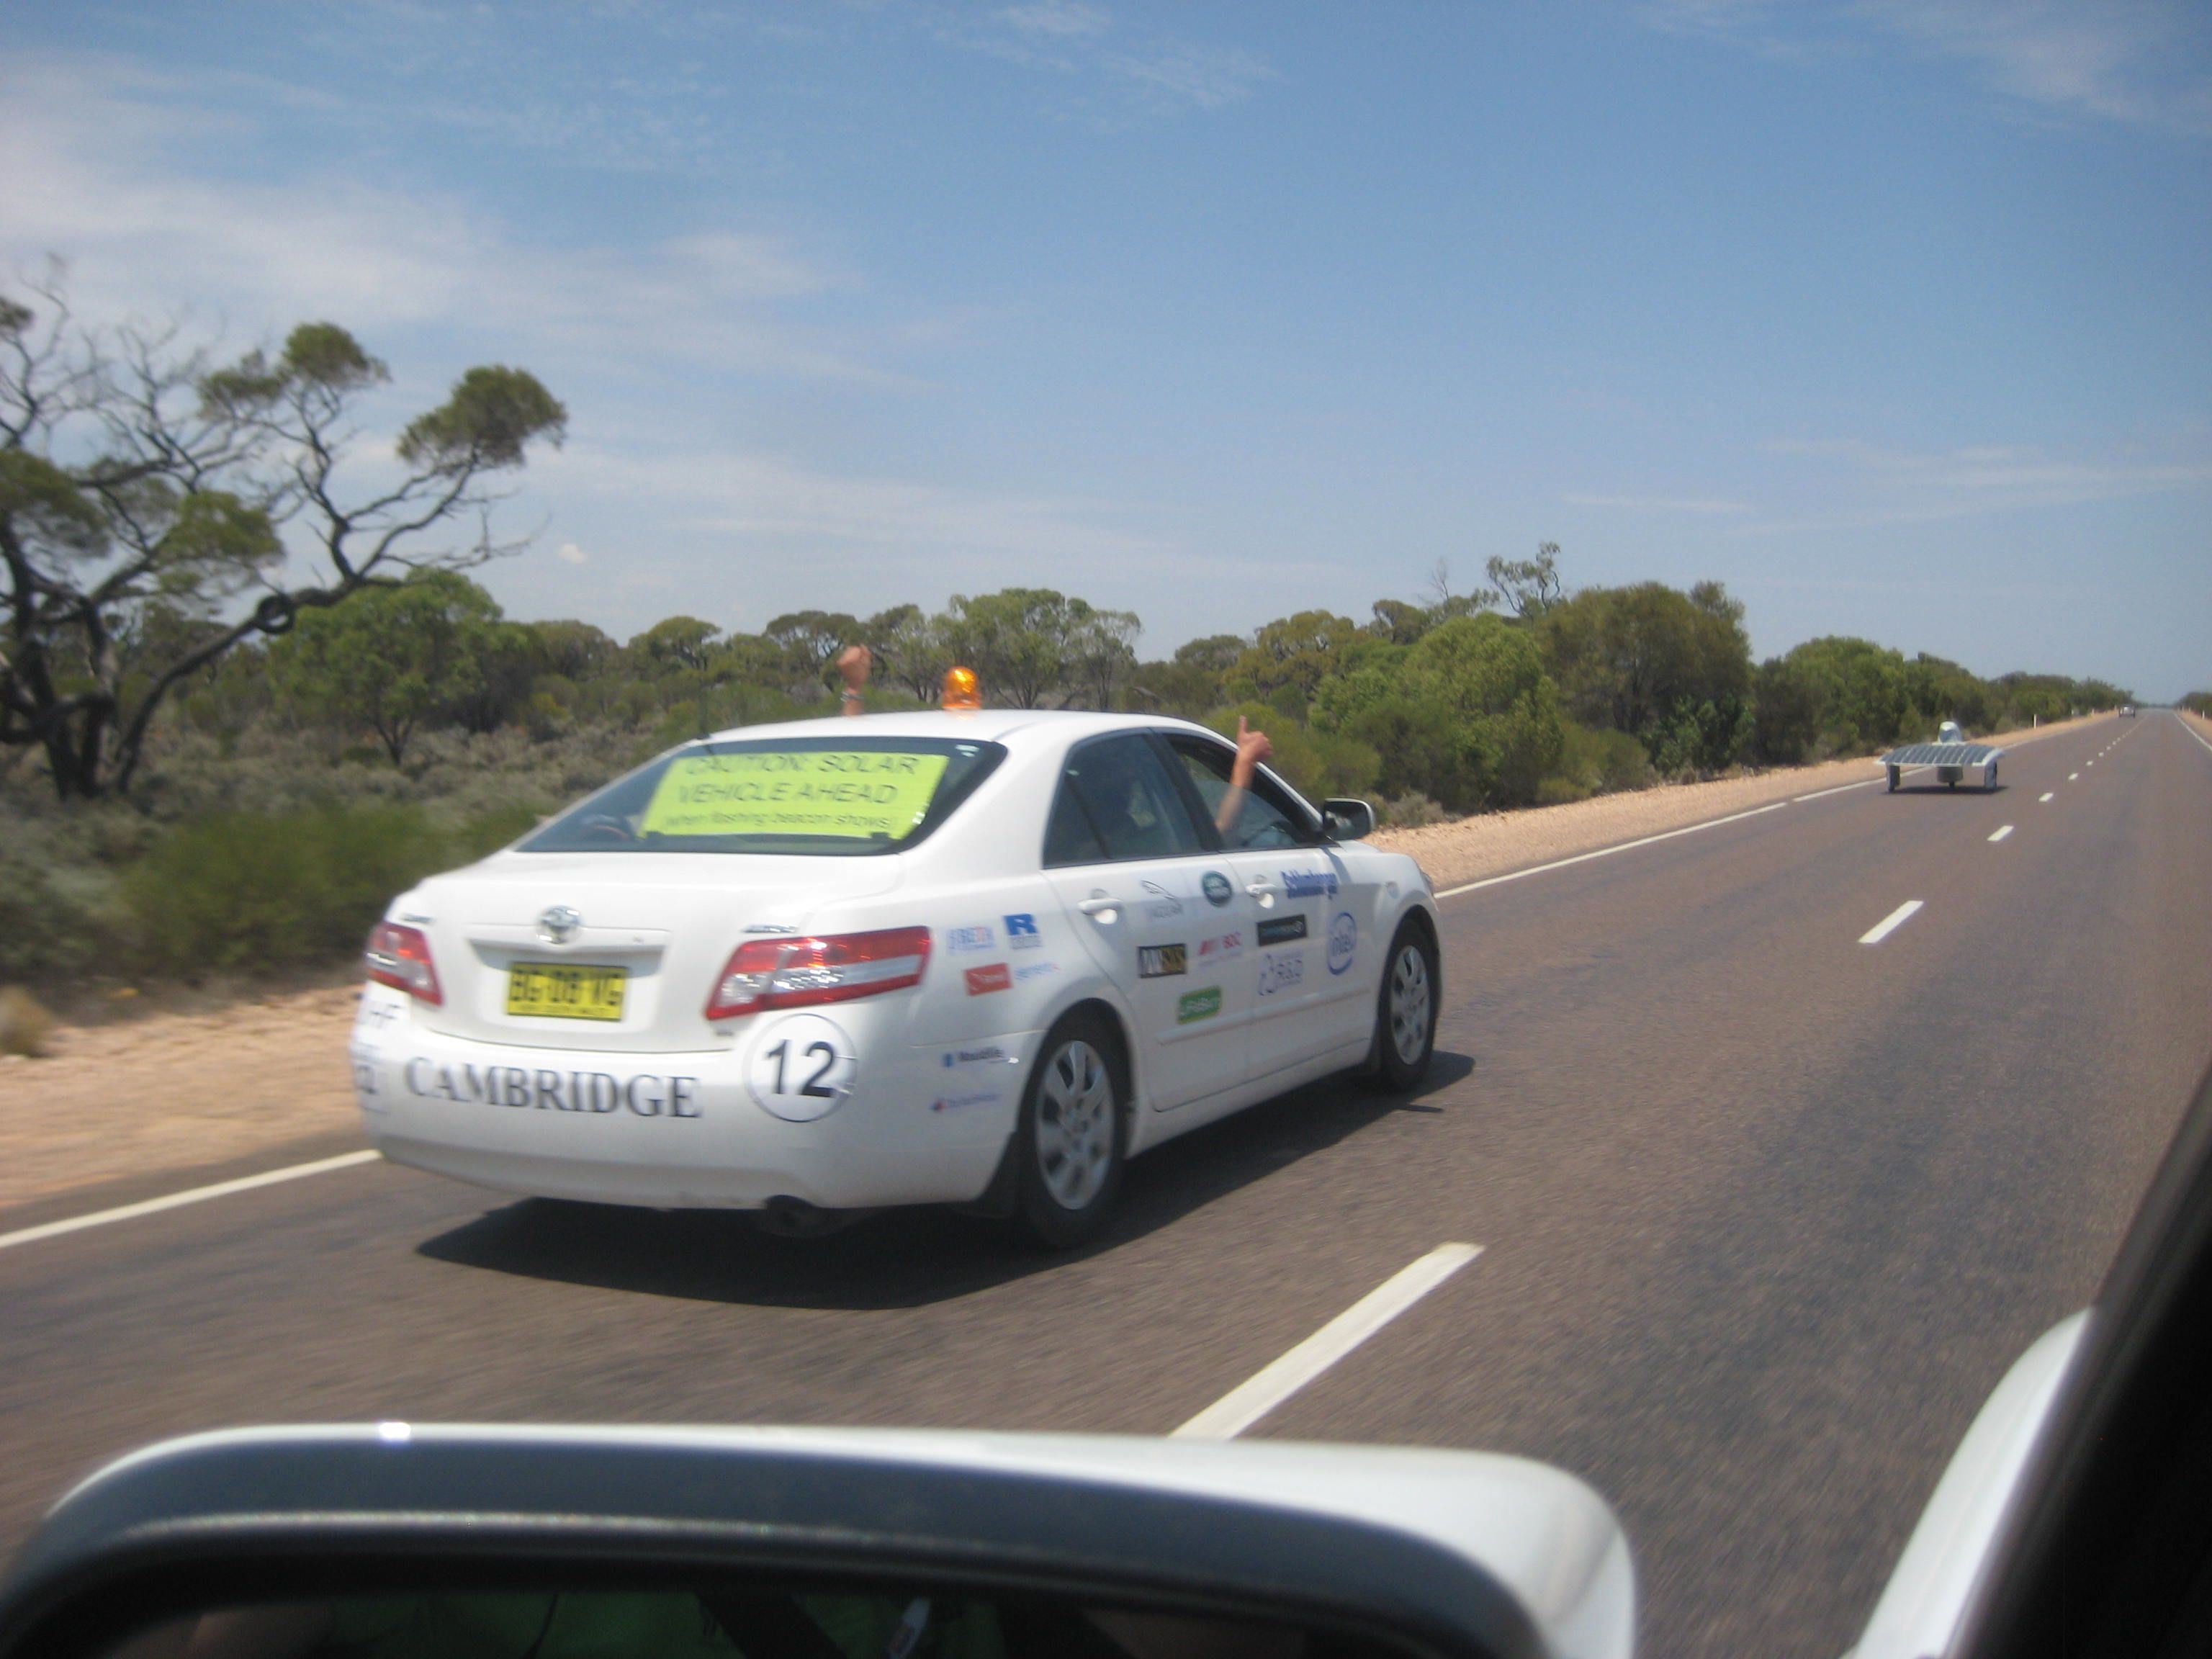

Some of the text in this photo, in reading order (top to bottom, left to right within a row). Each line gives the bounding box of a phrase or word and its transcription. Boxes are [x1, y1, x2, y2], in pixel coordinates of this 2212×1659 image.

[817, 755, 920, 775] SOLAR
[678, 782, 899, 804] VEHICLE AHEAD
[405, 1056, 703, 1118] CAMBRIDGE
[766, 1038, 837, 1098] 12
